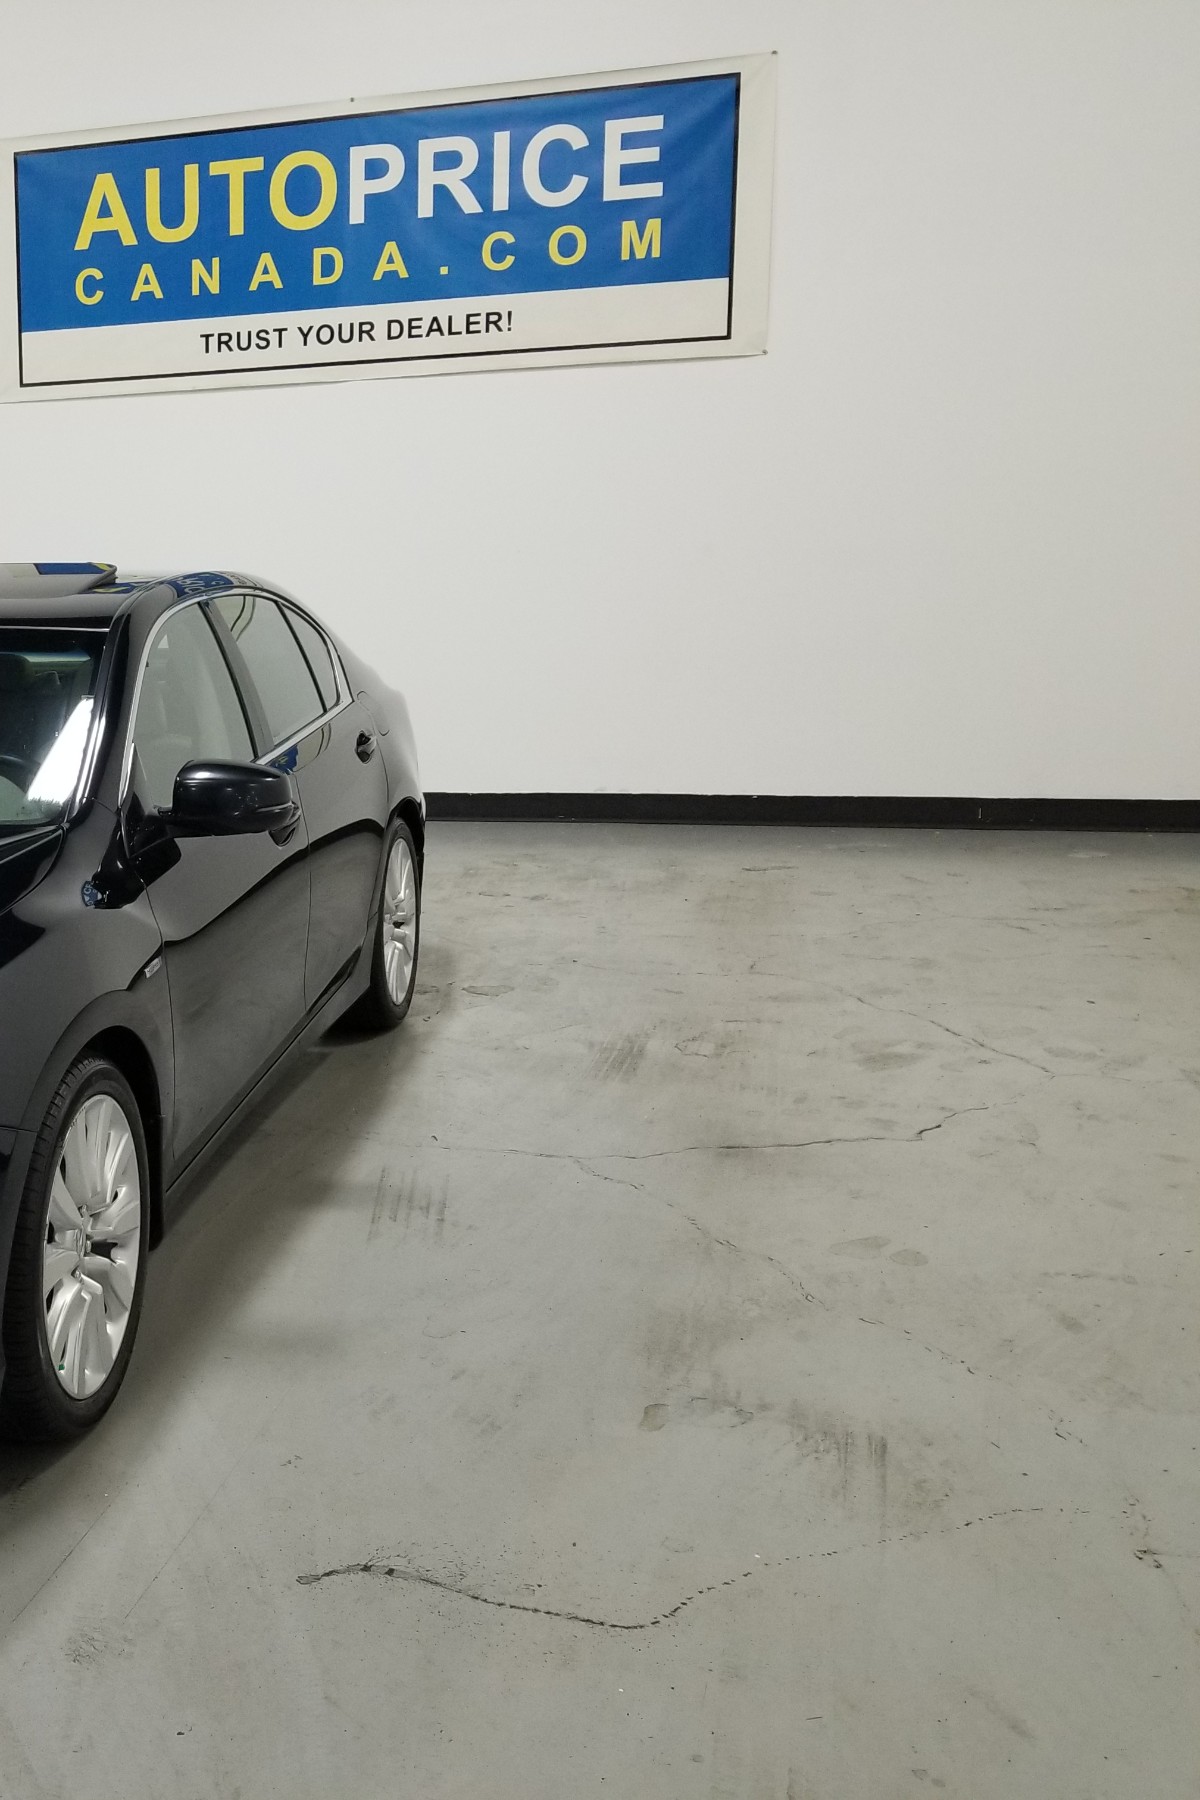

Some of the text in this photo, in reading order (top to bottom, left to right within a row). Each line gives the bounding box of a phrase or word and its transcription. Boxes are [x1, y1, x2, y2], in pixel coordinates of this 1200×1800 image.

[73, 114, 665, 251] AUTOPRICE
[74, 217, 663, 306] CANADA.COM
[199, 309, 513, 354] TRUST YOUR DEALER!
